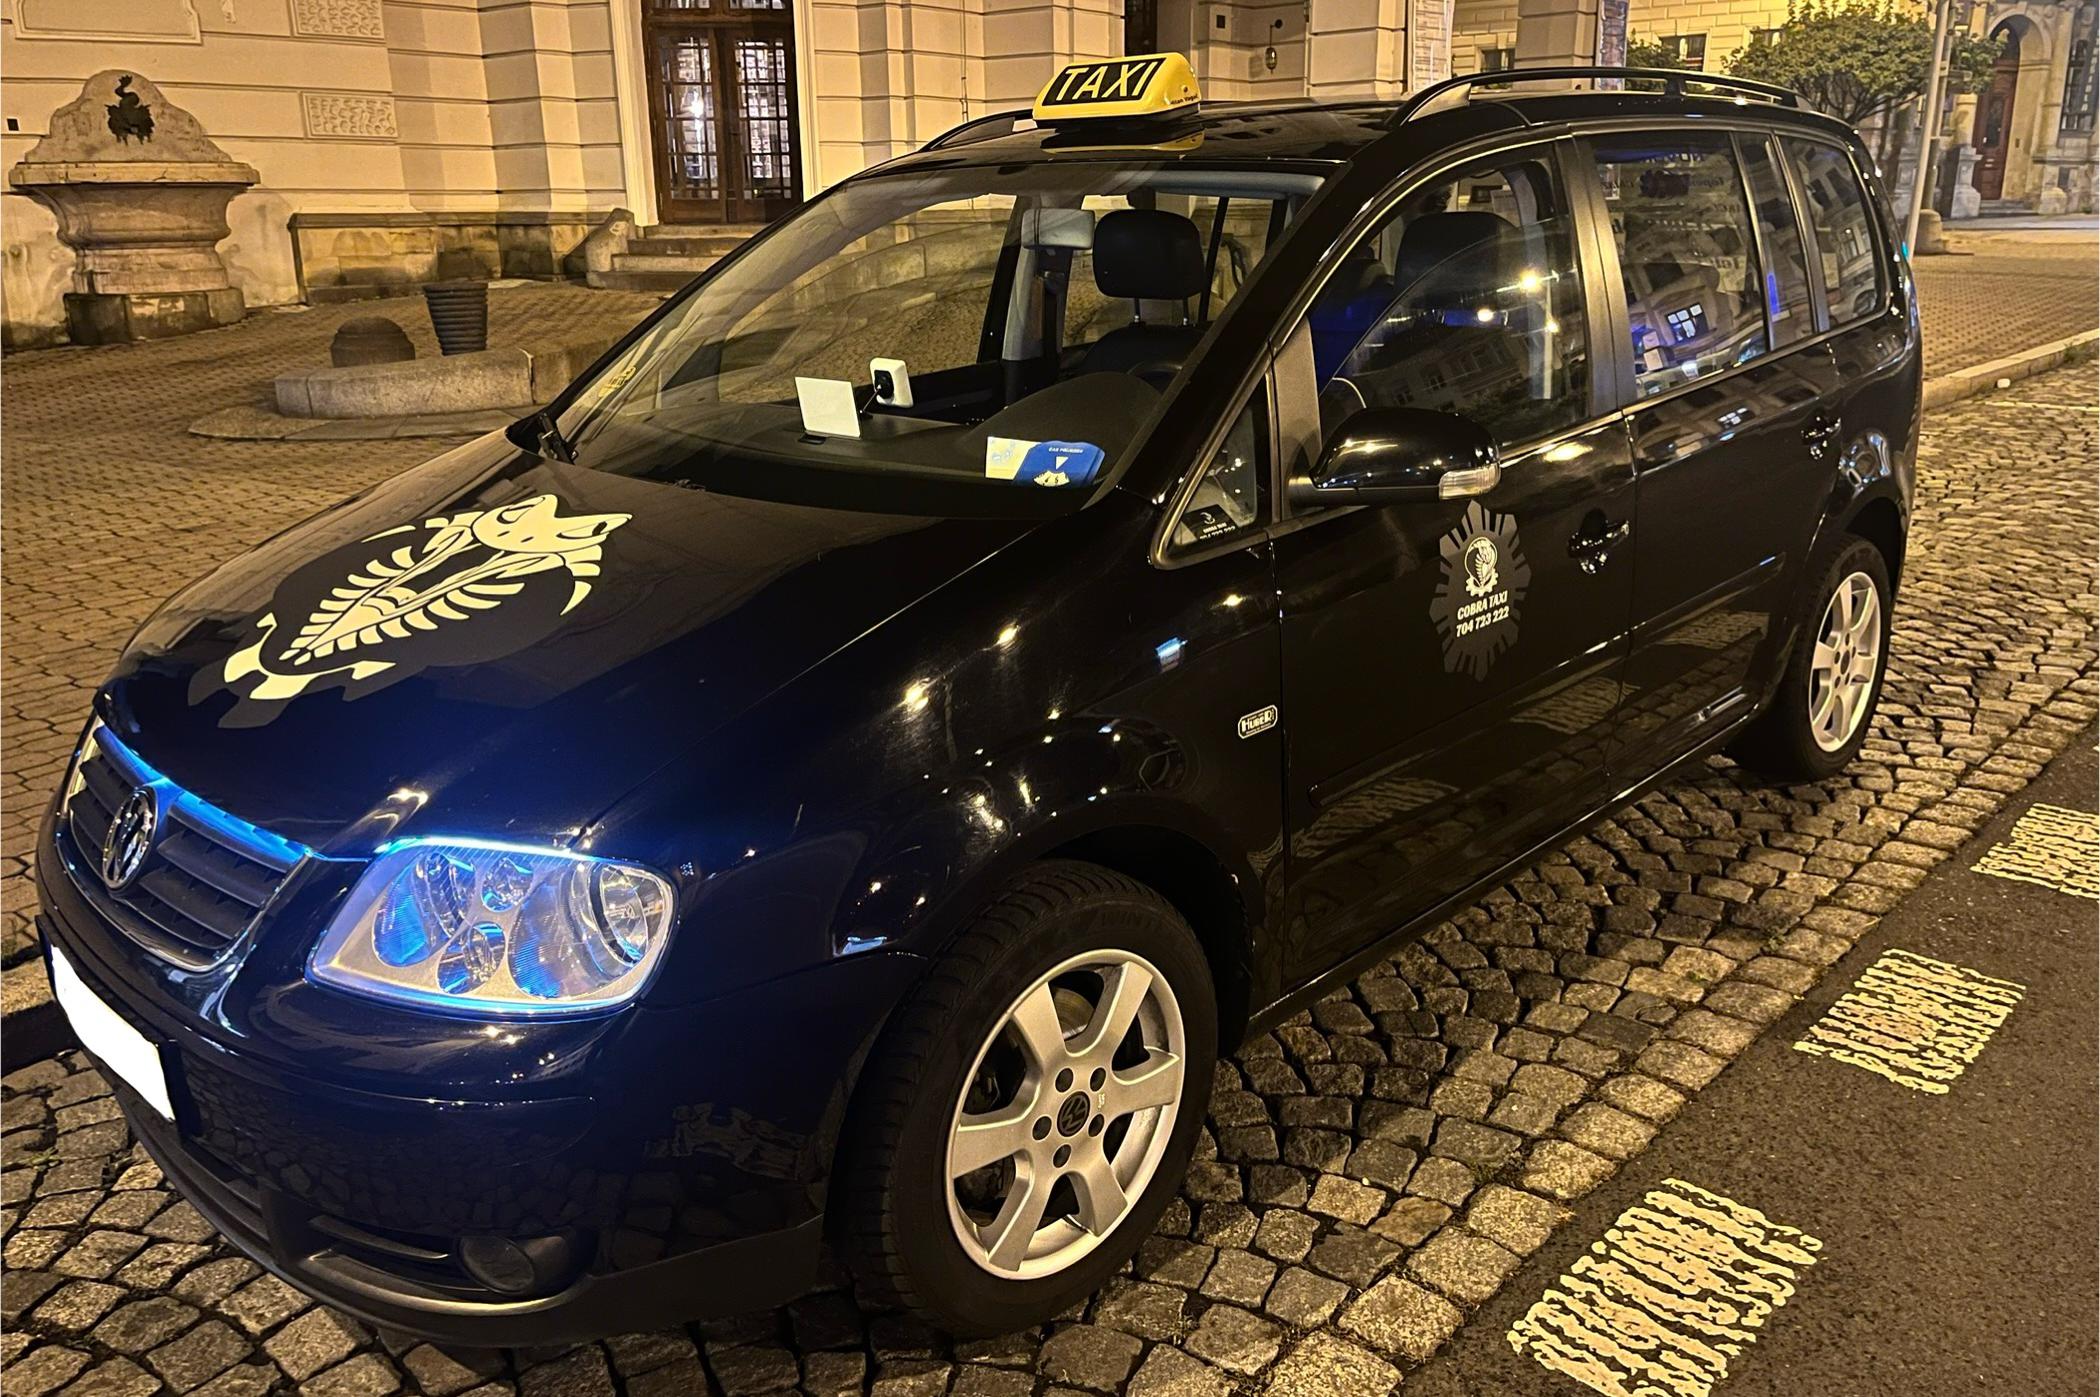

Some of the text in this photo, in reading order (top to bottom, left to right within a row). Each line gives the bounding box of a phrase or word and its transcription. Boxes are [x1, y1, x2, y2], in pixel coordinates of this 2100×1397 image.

[1056, 62, 1157, 101] TAXI
[1457, 590, 1508, 620] COBRA TAXI
[1456, 606, 1509, 637] 704 723 222
